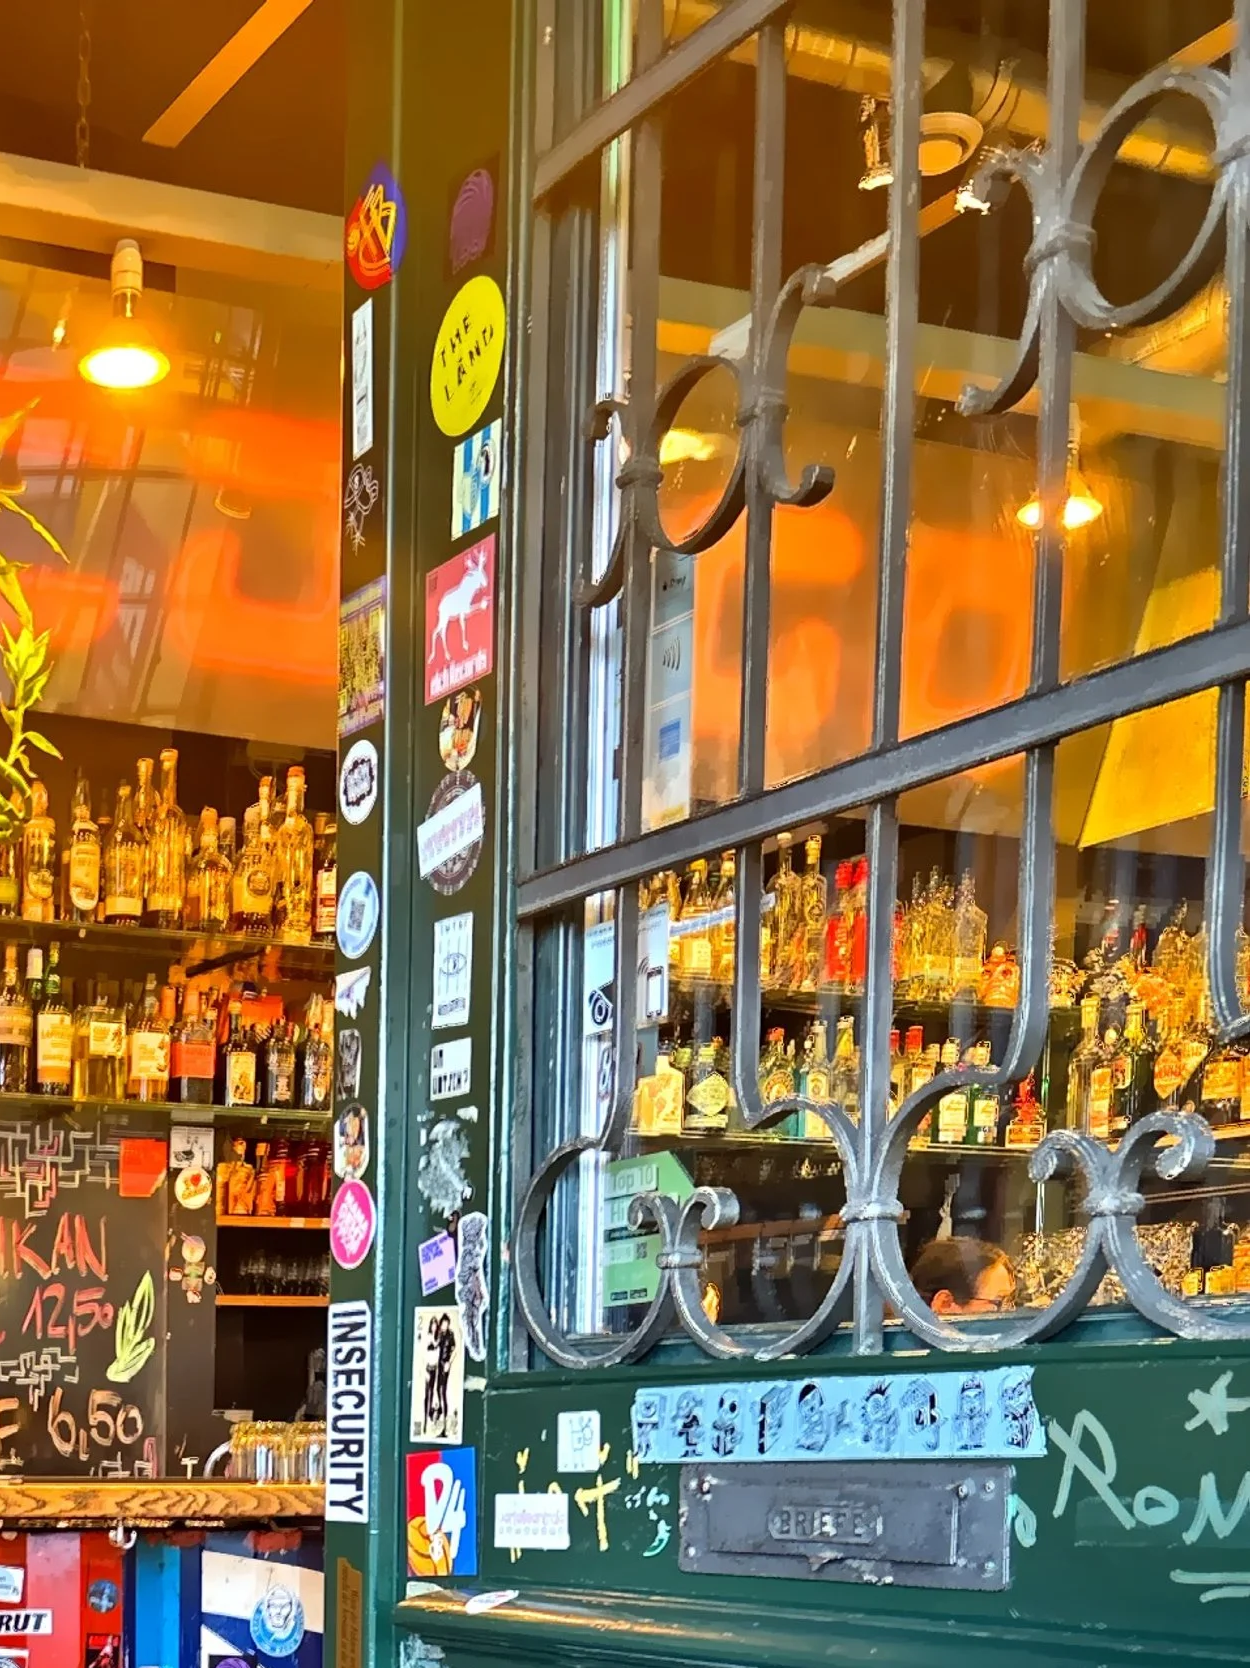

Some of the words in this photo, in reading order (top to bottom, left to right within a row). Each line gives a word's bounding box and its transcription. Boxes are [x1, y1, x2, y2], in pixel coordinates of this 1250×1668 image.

[22, 1282, 114, 1355] 12,50
[47, 1387, 143, 1461] 6,50
[329, 1310, 367, 1520] INSECURITY
[780, 1510, 864, 1537] BRIEFE
